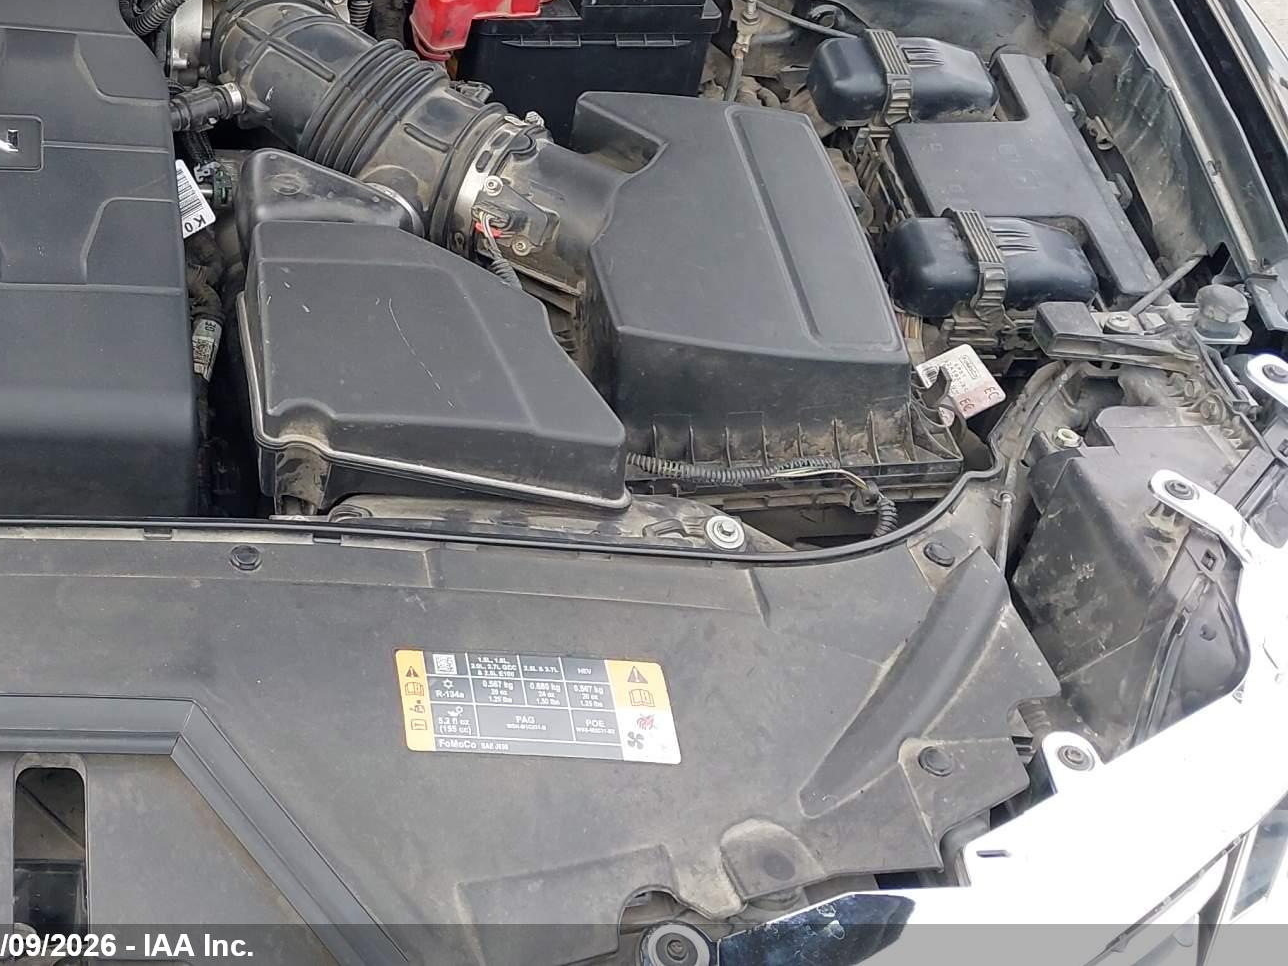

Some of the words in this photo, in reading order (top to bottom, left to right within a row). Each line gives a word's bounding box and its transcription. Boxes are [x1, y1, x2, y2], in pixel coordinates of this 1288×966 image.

[503, 680, 514, 691] kg
[551, 682, 561, 692] kg
[593, 685, 604, 694] kg
[435, 689, 465, 699] R-134a
[438, 717, 450, 725] 5.2
[515, 715, 536, 724] PAG
[585, 719, 606, 728] POE
[439, 738, 477, 749] FoMoCo
